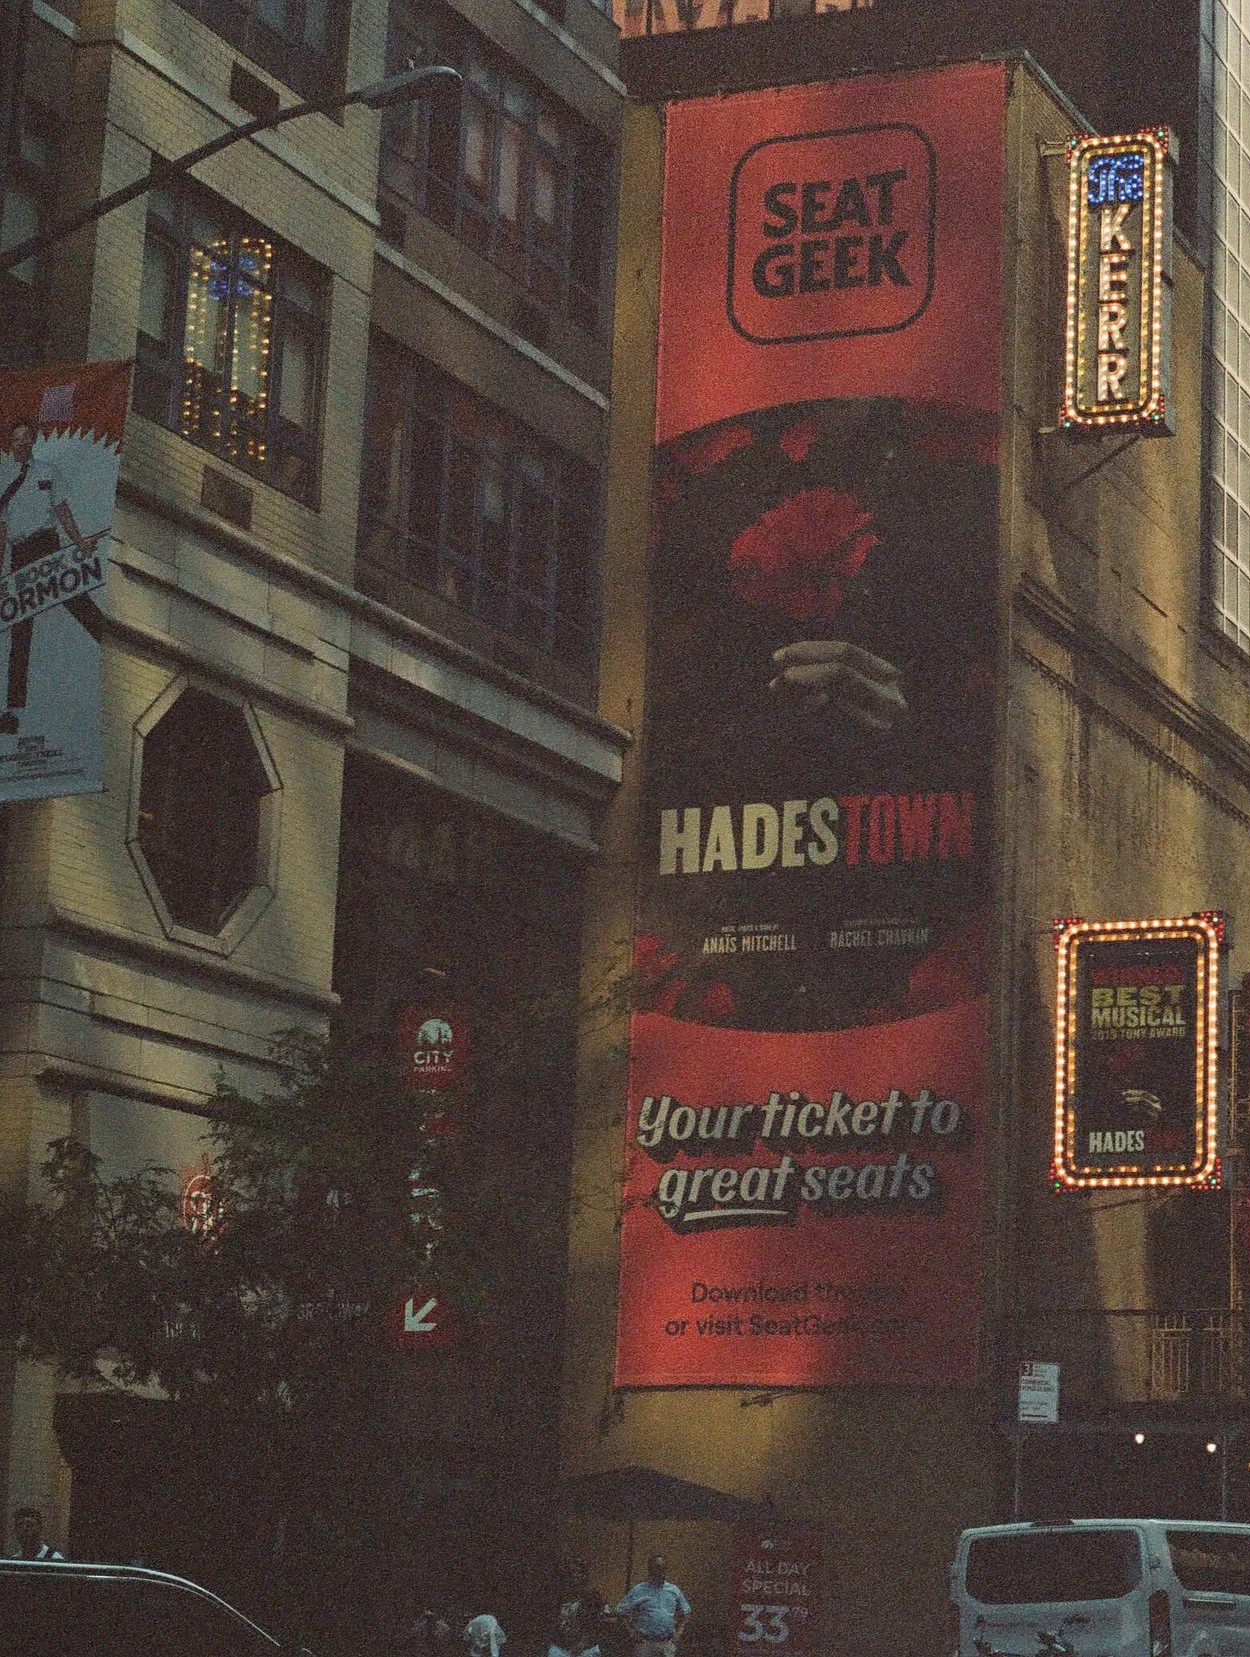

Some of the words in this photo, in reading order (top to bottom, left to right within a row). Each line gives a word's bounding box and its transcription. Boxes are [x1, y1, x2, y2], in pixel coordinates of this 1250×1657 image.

[1087, 154, 1144, 203] The
[763, 168, 907, 238] SEAT
[753, 230, 911, 297] GEEK
[1098, 204, 1132, 401] KERR
[15, 552, 67, 590] BOOK
[660, 792, 973, 875] HADESTOWN
[742, 933, 797, 953] MITCHELL
[1091, 984, 1185, 1007] BEST
[1091, 1005, 1187, 1029] MUSICAL
[413, 1049, 454, 1065] CITY
[760, 1089, 902, 1138] ticket
[910, 1089, 961, 1136] to
[658, 1155, 797, 1219] great
[800, 1153, 936, 1202] seats
[691, 1281, 808, 1304] Download
[664, 1319, 690, 1337] or
[697, 1315, 743, 1336] visit
[745, 1557, 774, 1575] ALL
[777, 1560, 811, 1578] DAY
[741, 1577, 812, 1597] SPECIAL
